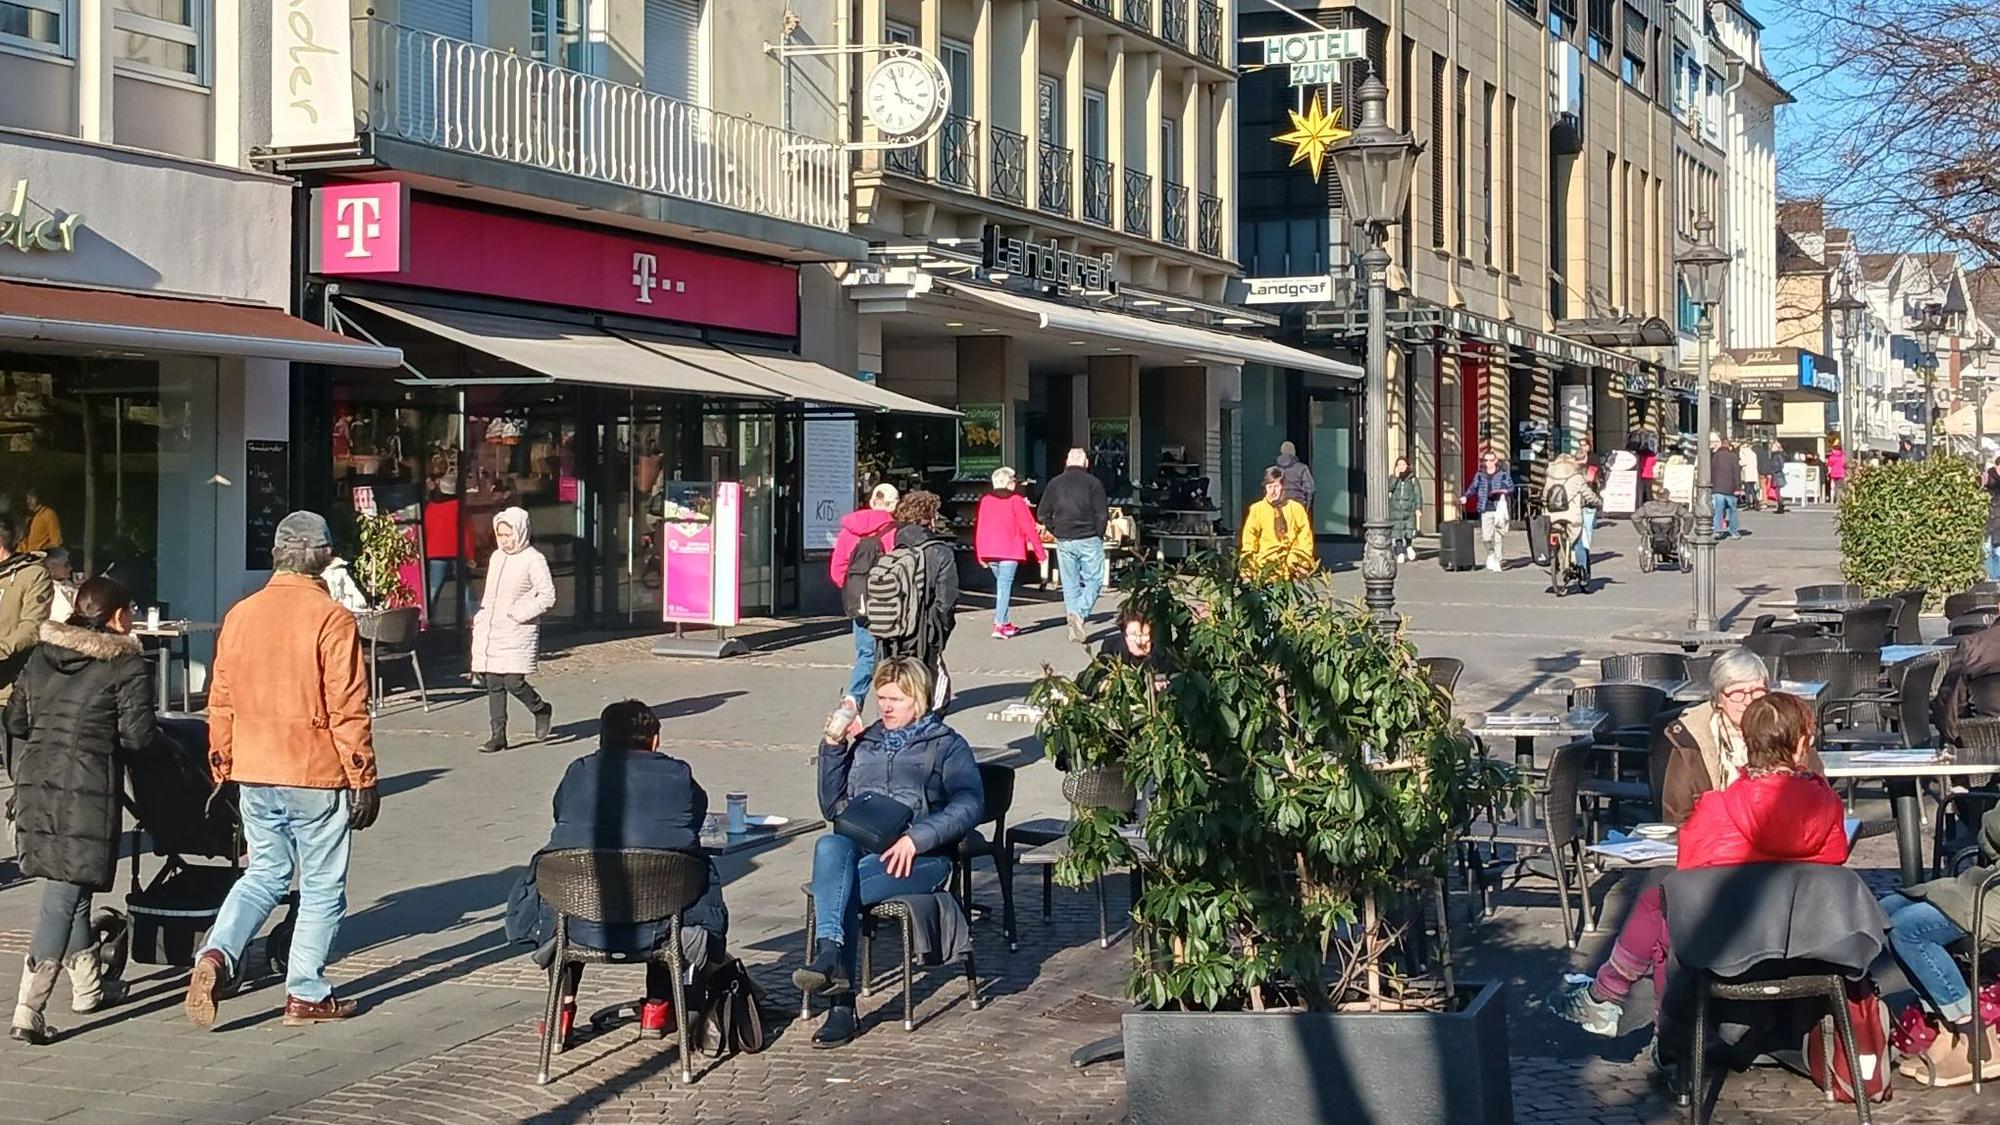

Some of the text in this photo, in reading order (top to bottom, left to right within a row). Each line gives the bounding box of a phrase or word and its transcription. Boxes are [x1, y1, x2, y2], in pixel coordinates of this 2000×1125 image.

[288, 0, 340, 124] der
[1266, 31, 1359, 63] HOTEL
[1292, 63, 1336, 84] ZUM
[337, 197, 381, 258] T
[991, 224, 1113, 297] Landgraf
[1249, 281, 1327, 298] Landgraf
